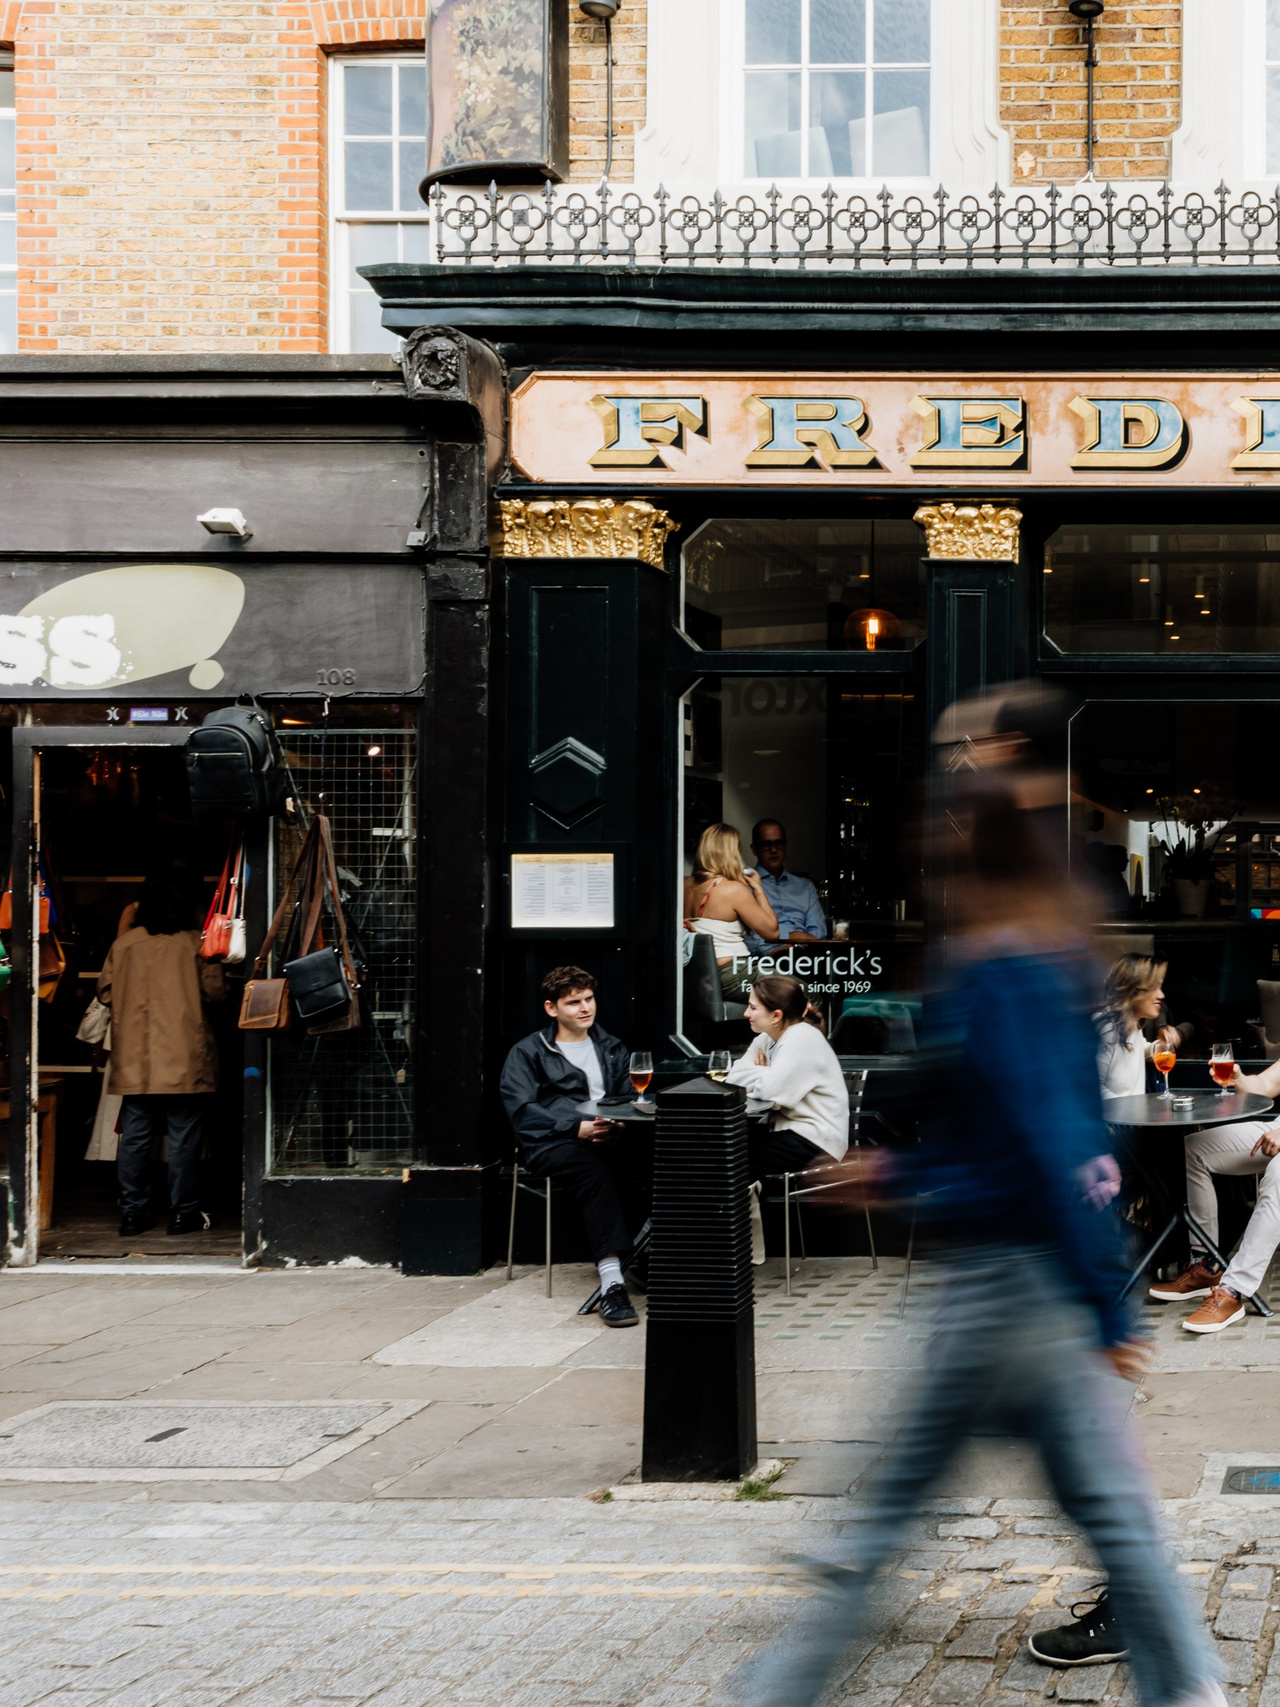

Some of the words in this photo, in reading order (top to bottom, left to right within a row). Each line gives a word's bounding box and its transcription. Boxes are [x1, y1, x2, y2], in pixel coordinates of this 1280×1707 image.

[316, 668, 356, 686] 108
[732, 946, 882, 976] Frederick's
[807, 980, 840, 993] since
[843, 980, 871, 993] 1969
